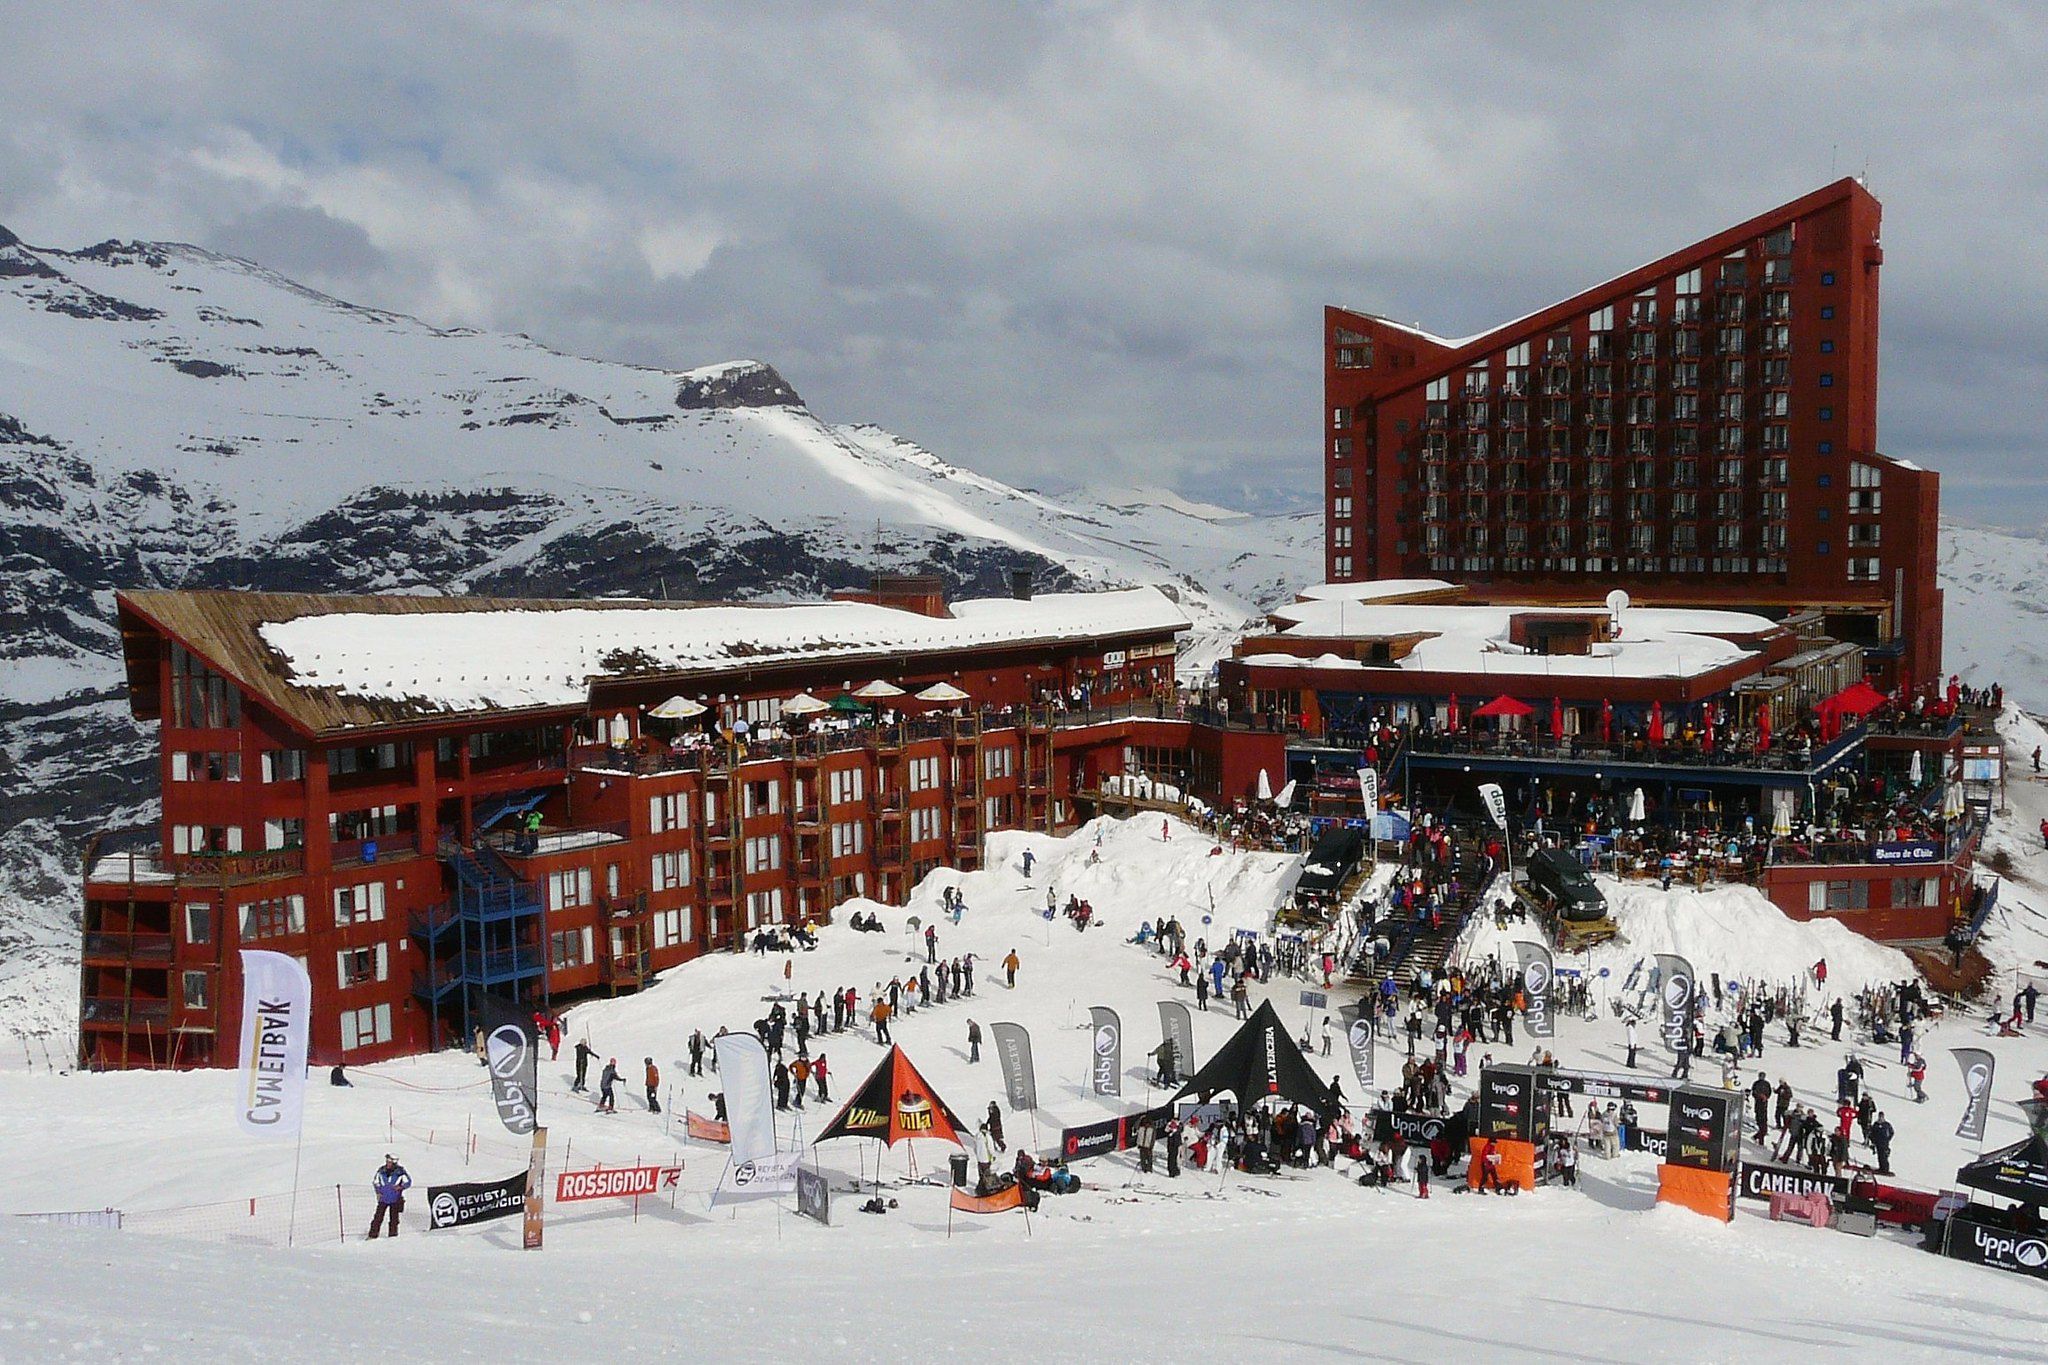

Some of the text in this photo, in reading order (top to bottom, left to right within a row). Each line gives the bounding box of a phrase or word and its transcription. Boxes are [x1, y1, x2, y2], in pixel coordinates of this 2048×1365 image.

[1876, 848, 1934, 859] Banco de Chile
[1265, 1026, 1277, 1083] LA TERCERA
[458, 1188, 507, 1207] REVISTA
[561, 1169, 656, 1198] ROSSIGNOL
[1749, 1170, 1835, 1205] CAMELBAK
